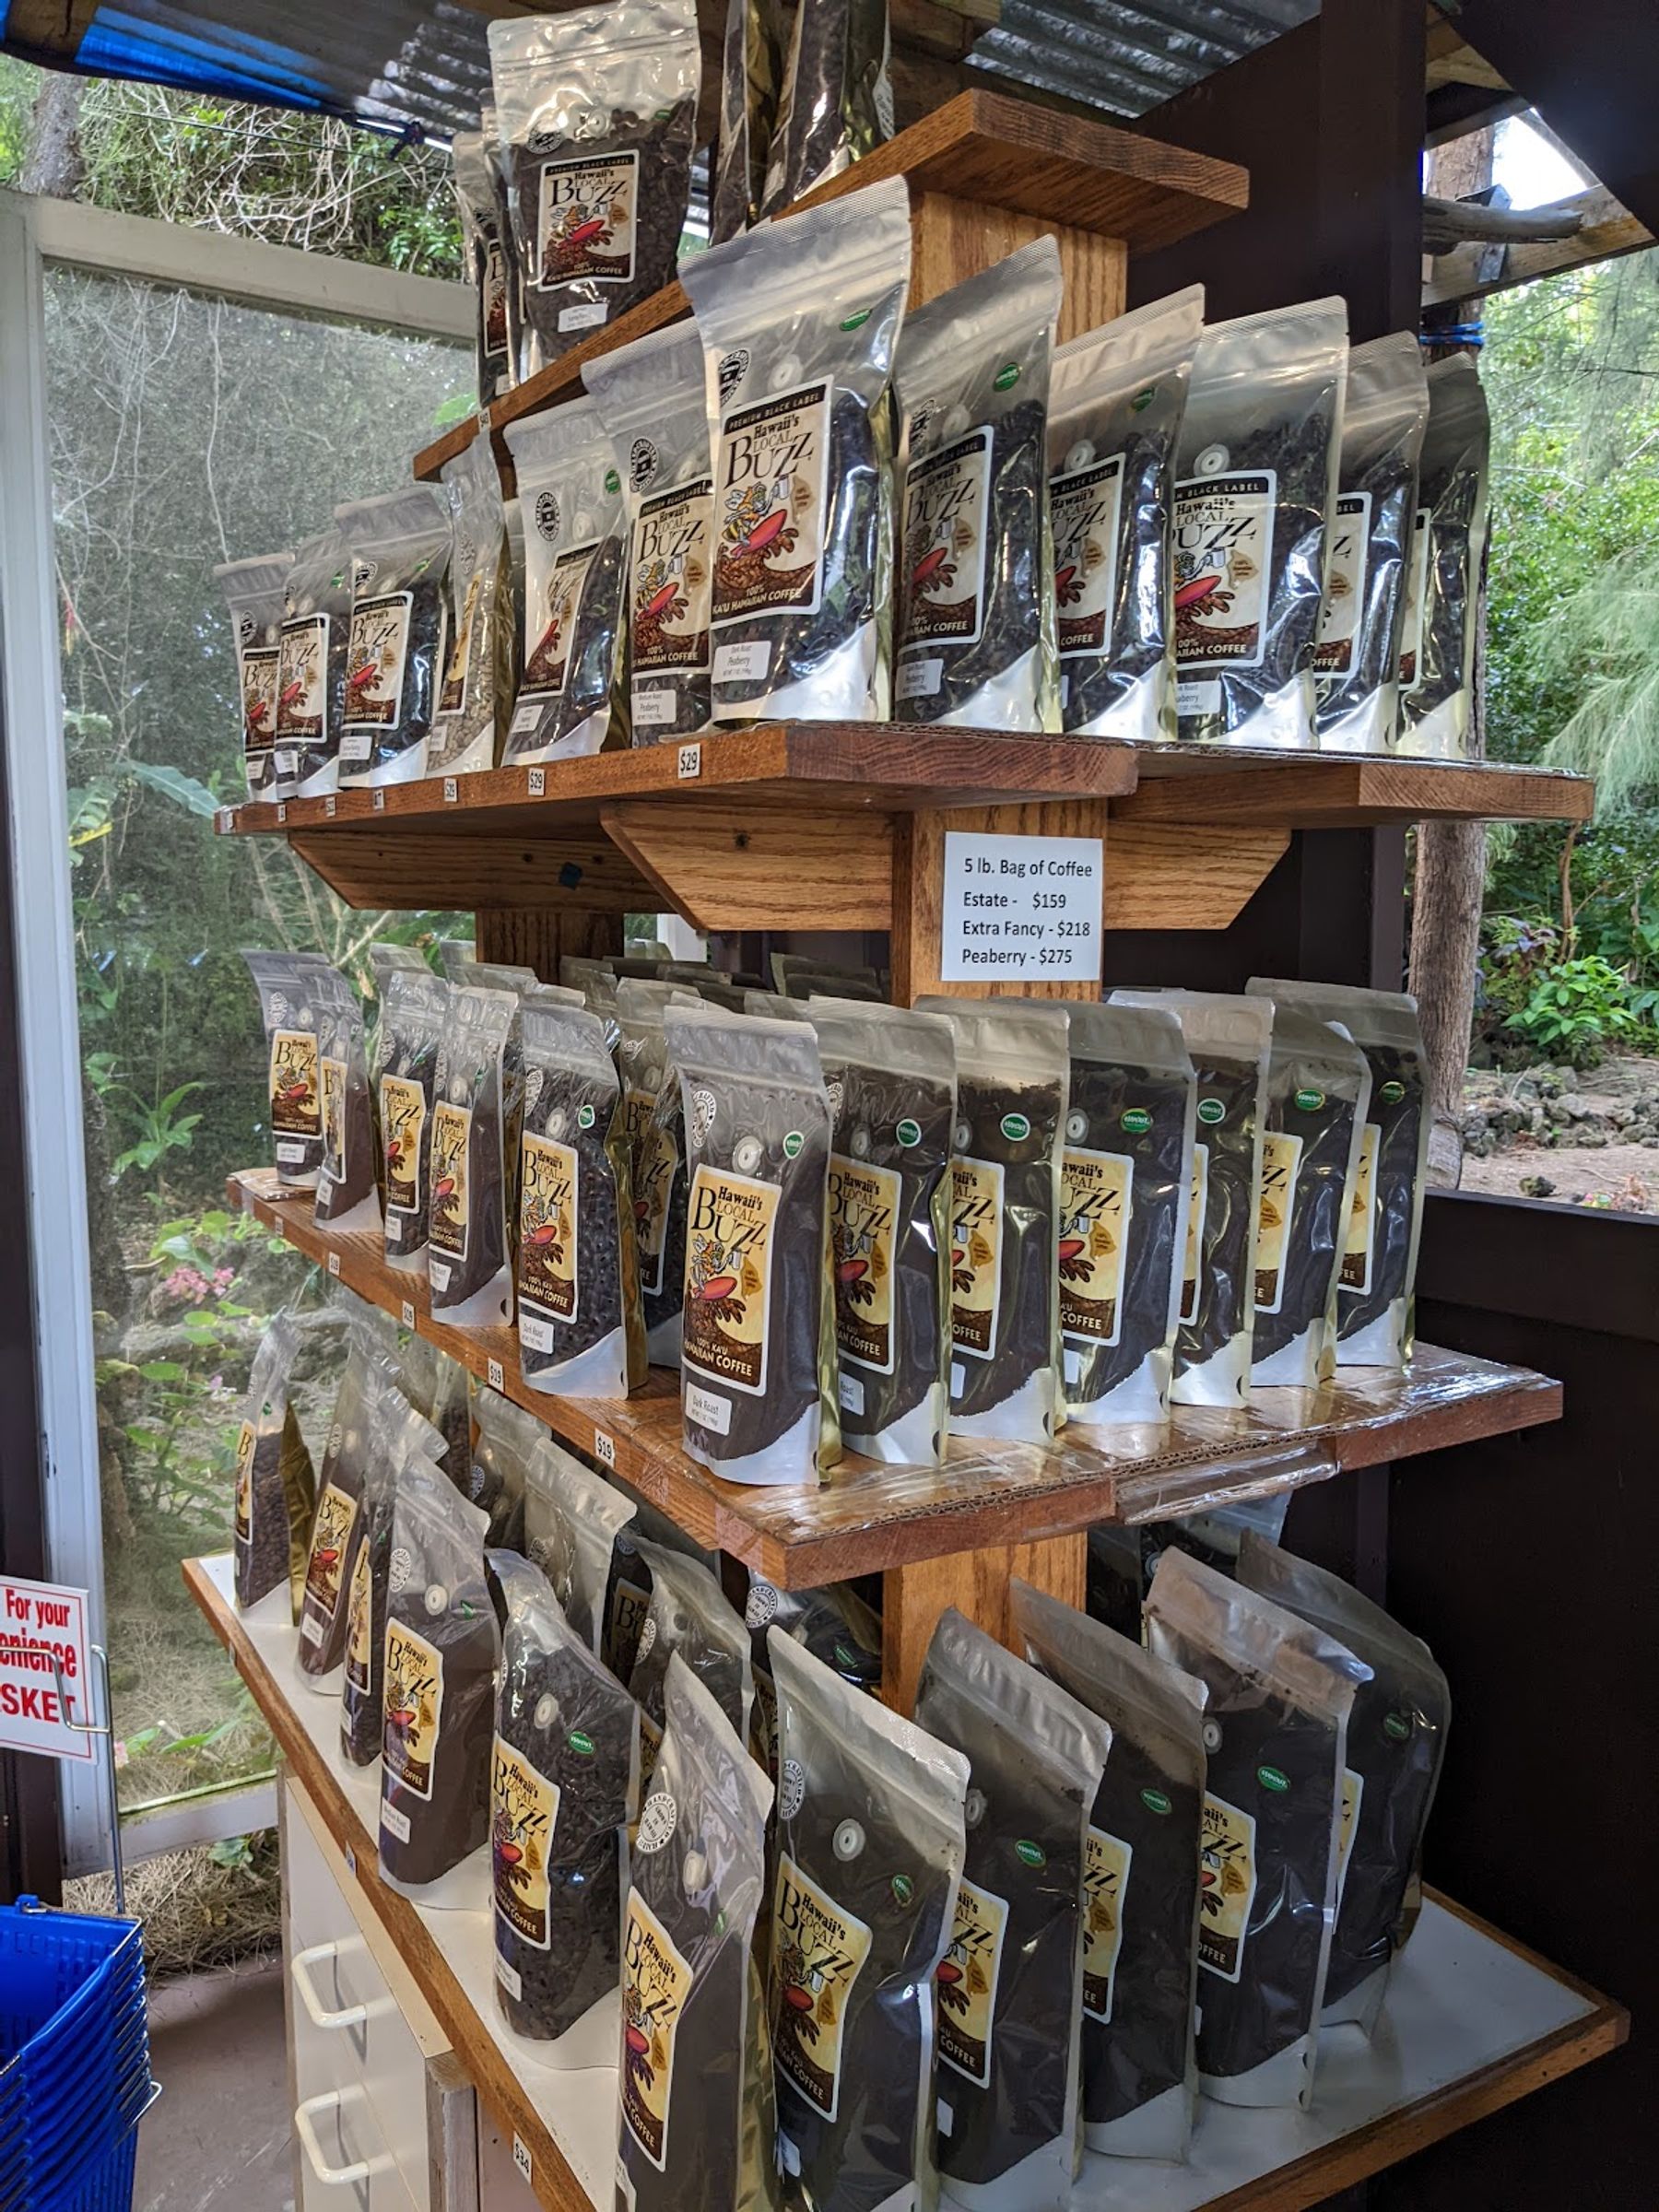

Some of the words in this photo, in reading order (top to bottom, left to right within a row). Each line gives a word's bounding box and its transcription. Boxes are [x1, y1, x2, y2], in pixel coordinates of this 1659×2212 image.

[574, 169, 615, 180] Hawaii's
[548, 178, 628, 208] BUZZ
[595, 265, 623, 276] COFFEE
[729, 411, 762, 429] PREMIUM
[764, 402, 791, 418] BLACK
[793, 393, 819, 407] LABEL
[754, 413, 800, 440] Hawaii's
[753, 430, 794, 453] LOCAL
[724, 431, 815, 489] BUZZ
[1052, 488, 1095, 508] Hawaii's
[1187, 485, 1220, 499] BLACK
[1224, 482, 1260, 493] LABEL
[659, 502, 690, 524] Hawaii's
[906, 478, 975, 532] BUZZ
[1176, 497, 1236, 517] Hawaii's
[658, 517, 687, 535] LOCAL
[1052, 501, 1106, 542] UZZ
[1177, 512, 1230, 524] LOCAL
[637, 520, 705, 564] BUZZ
[1173, 517, 1256, 549] UZZ
[746, 583, 765, 597] 100%
[769, 587, 802, 601] COFFEE
[352, 618, 398, 645] BUZZ
[933, 620, 968, 632] COFFEE
[1060, 633, 1094, 645] COFFEE
[1206, 643, 1247, 655] COFFEE
[667, 651, 699, 662] COFFEE
[1311, 657, 1341, 666] OFFEE
[244, 664, 276, 688] BUZ
[680, 750, 698, 774] $29
[529, 771, 543, 790] $29
[964, 857, 973, 874] 5
[977, 857, 995, 874] lb.
[1000, 859, 1026, 878] Bag
[1030, 859, 1045, 876] of
[1047, 860, 1092, 877] Coffee
[963, 891, 1008, 908] Estate
[1032, 891, 1066, 911] $159
[962, 920, 1000, 935] Extra
[1004, 921, 1045, 939] Fancy
[1056, 919, 1090, 938] $218
[961, 947, 1027, 967] Peaberry
[1039, 947, 1073, 966] $275
[536, 1162, 560, 1181] LOCAL
[537, 1149, 563, 1171] Hawaii's
[1062, 1161, 1103, 1179] awaii's
[524, 1148, 572, 1206] BUZZ
[842, 1171, 880, 1195] Hawaii's
[953, 1171, 978, 1187] waii's
[1062, 1173, 1097, 1191] OCAL
[718, 1185, 763, 1211] Hawaii's
[829, 1172, 891, 1239] BUZZ
[842, 1186, 875, 1207] LOCAL
[1062, 1185, 1121, 1220] UZZ
[691, 1186, 767, 1254] BUZZ
[716, 1201, 755, 1224] LOCAL
[953, 1196, 995, 1230] ZZ
[544, 1291, 569, 1308] COFFEE
[1062, 1311, 1102, 1330] COFFEE
[953, 1324, 982, 1342] OFFEE
[712, 1340, 729, 1356] KA'U
[849, 1335, 881, 1357] COFFEE
[489, 1364, 502, 1383] $19
[715, 1355, 753, 1378] COFFEE
[597, 1437, 612, 1460] $19
[6, 1588, 31, 1620] For
[35, 1599, 70, 1630] your
[386, 1636, 437, 1699] BUZZ
[0, 1682, 76, 1724] SKET
[403, 1768, 423, 1787] COFFEE
[510, 1762, 539, 1799] Hawaii's
[493, 1754, 547, 1837] BUZZ
[506, 1776, 534, 1807] LOCAL
[1204, 1807, 1229, 1829] aii's
[1202, 1830, 1247, 1864] ZZ
[1085, 1865, 1118, 1897] ZZ
[957, 1891, 979, 1915] aii's
[512, 1911, 537, 1936] COFFEE
[801, 1892, 847, 1940] Hawaii's
[778, 1876, 856, 1985] BUZZ
[799, 1908, 838, 1950] LOCAL
[953, 1917, 994, 1955] ZZ
[642, 1930, 677, 1983] Hawaii's
[1198, 1941, 1227, 1965] OFFEE
[626, 1917, 678, 2032] BUZZ
[640, 1946, 668, 1995] LOCAL
[939, 2034, 976, 2068] COFFEE
[793, 2064, 824, 2100] COFFEE
[630, 2111, 656, 2148] COFFEE
